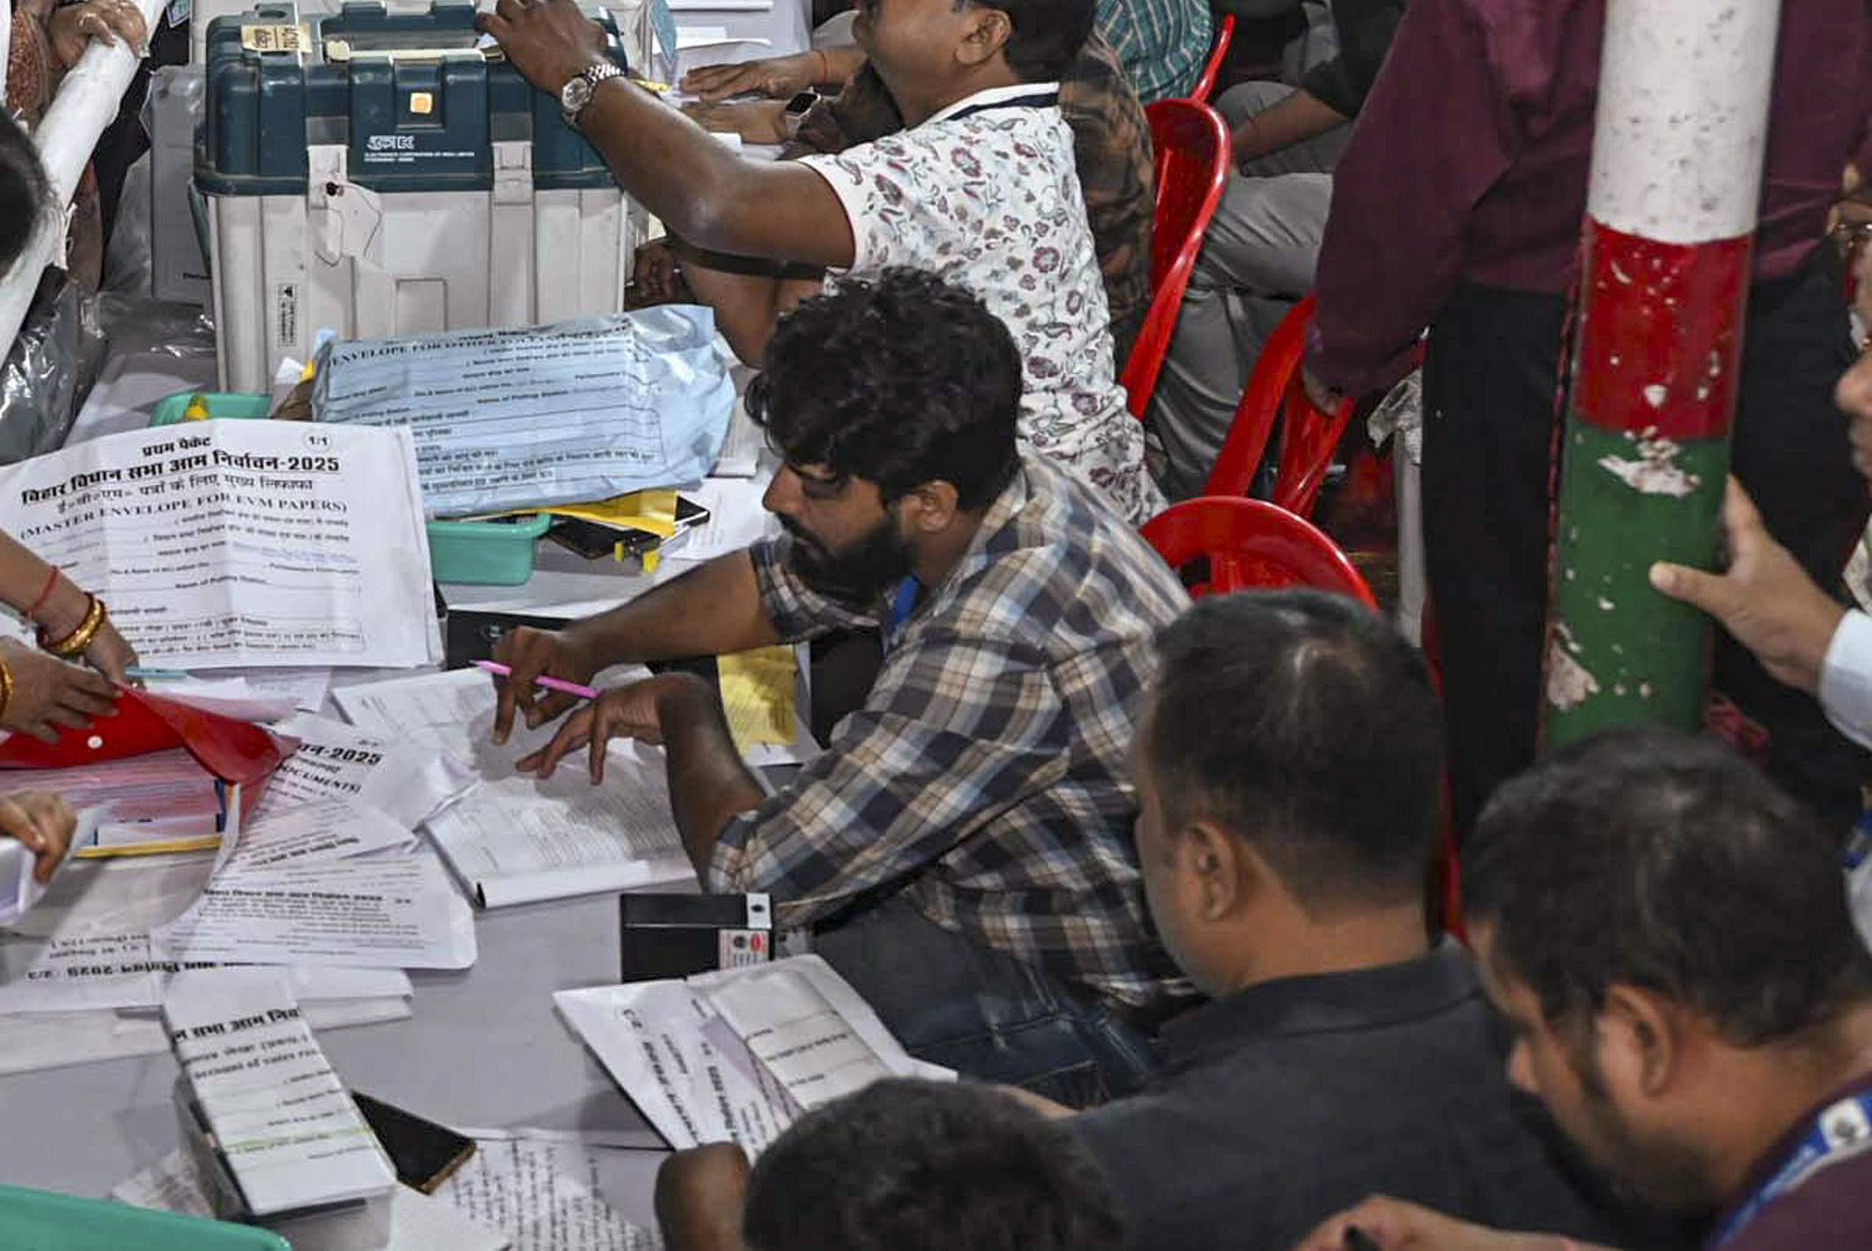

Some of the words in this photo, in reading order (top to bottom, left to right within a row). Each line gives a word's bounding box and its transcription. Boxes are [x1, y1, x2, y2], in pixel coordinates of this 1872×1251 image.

[21, 482, 67, 506] बिहार
[70, 469, 122, 491] विधान
[128, 462, 163, 480] सभा
[169, 454, 207, 472] आम
[99, 499, 190, 518] ENVELOPE
[197, 492, 231, 507] FOR
[236, 494, 273, 509] EVM
[278, 498, 348, 514] PAPERS)
